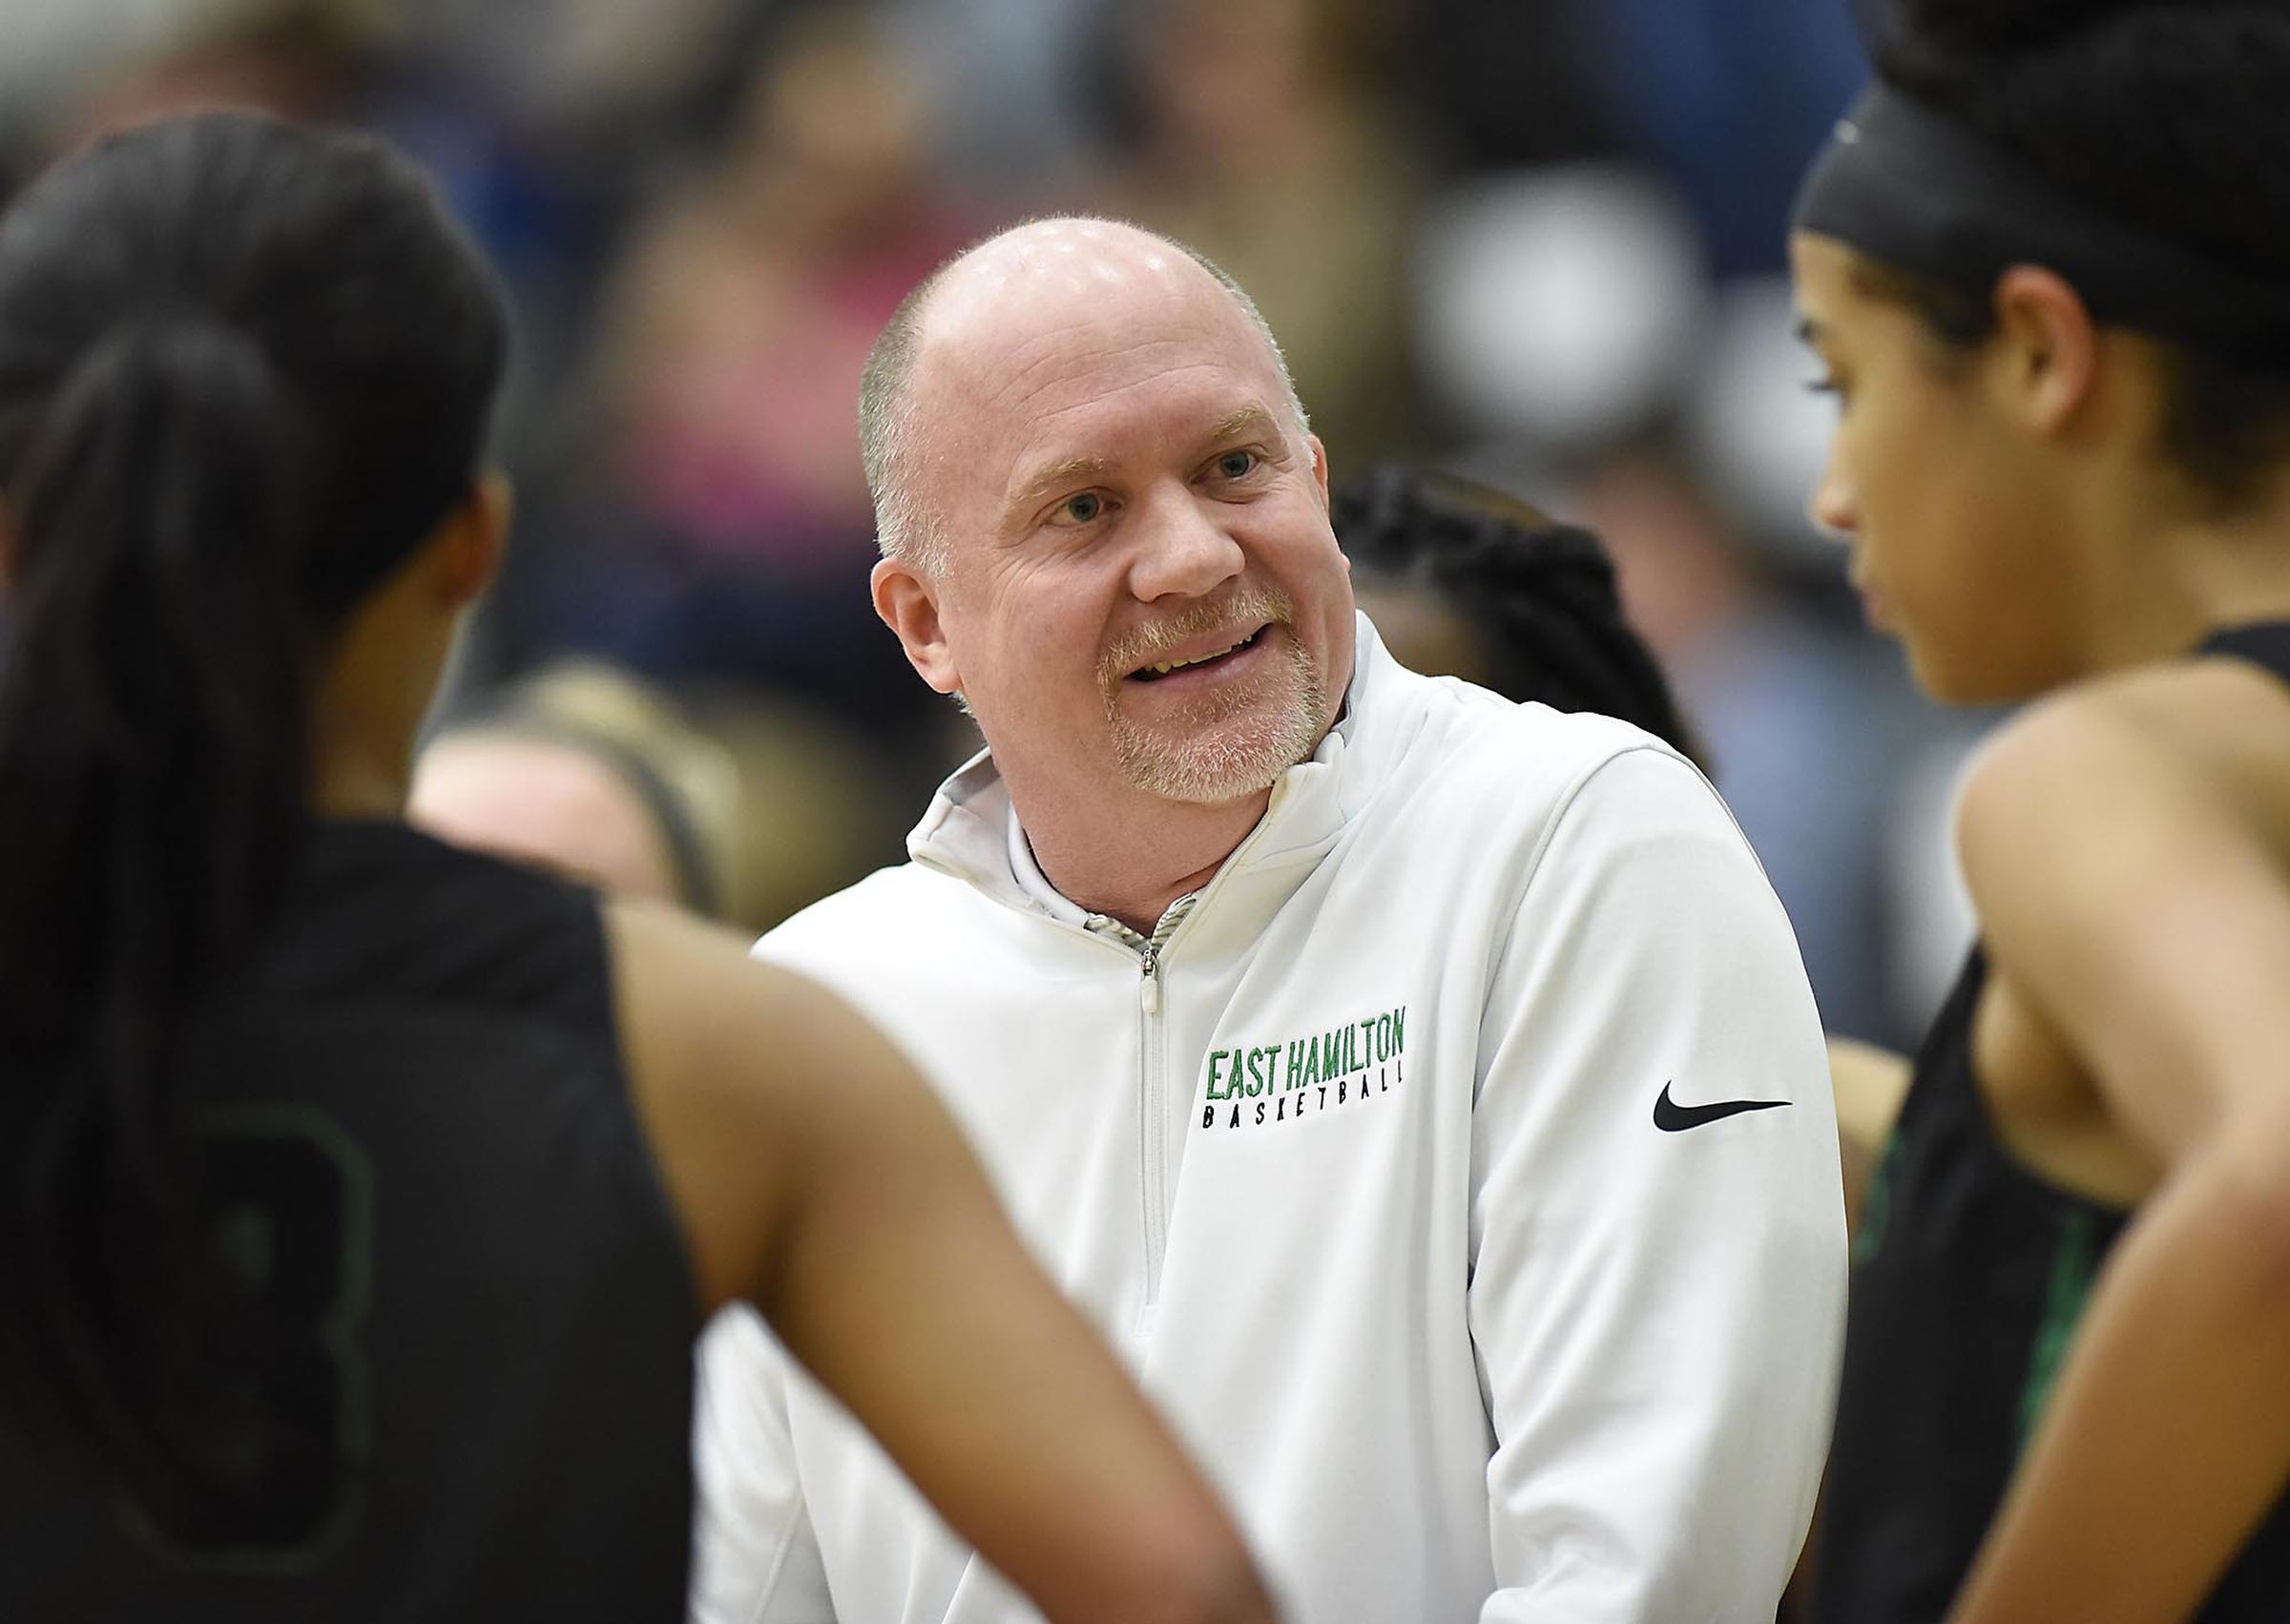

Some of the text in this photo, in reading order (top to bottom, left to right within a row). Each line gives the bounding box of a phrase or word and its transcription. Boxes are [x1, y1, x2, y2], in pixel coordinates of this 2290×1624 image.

[1206, 1006, 1405, 1100] EAST HAMILTON
[1202, 1060, 1403, 1128] BASKETBALL
